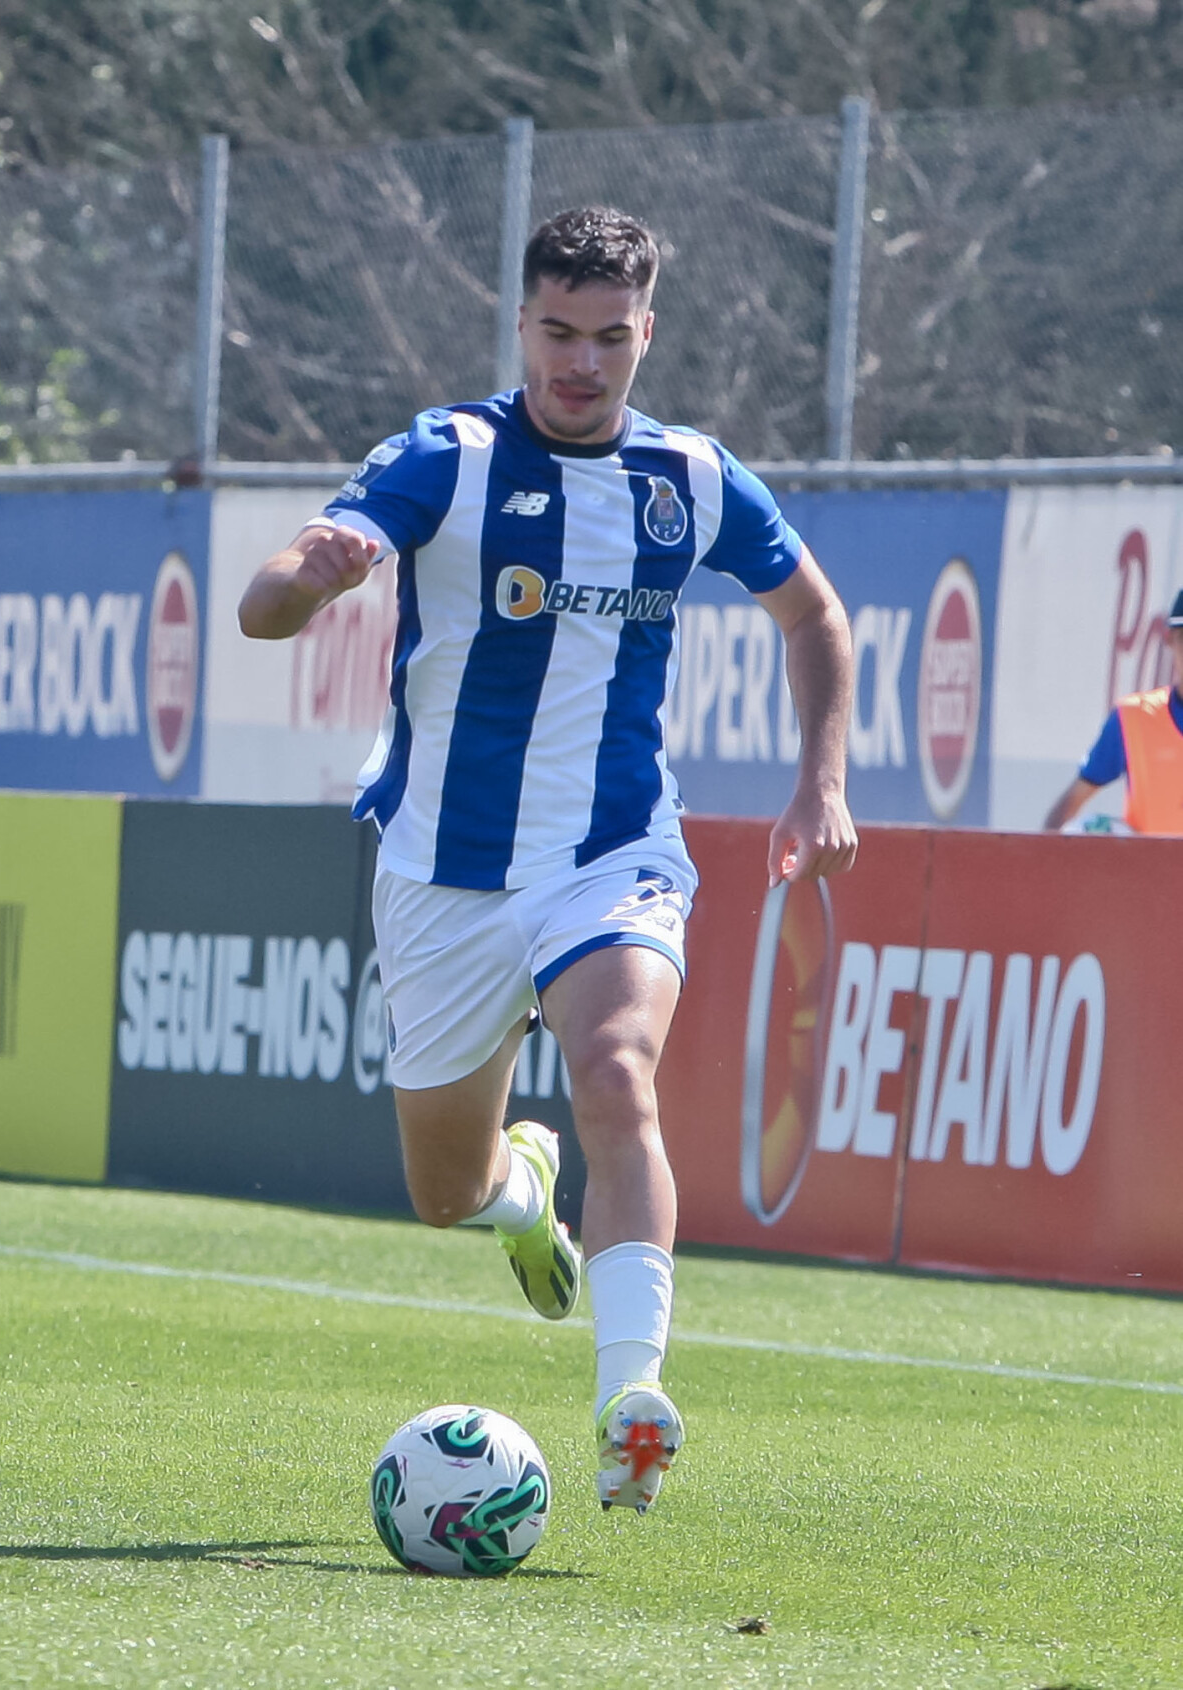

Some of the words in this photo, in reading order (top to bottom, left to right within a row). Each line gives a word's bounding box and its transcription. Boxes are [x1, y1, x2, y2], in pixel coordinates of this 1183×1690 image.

[39, 592, 142, 739] BOCK
[544, 580, 674, 621] BETANO
[667, 603, 776, 762] UPER
[118, 930, 351, 1083] SEGUE-NOS
[817, 941, 1106, 1176] BETANO
